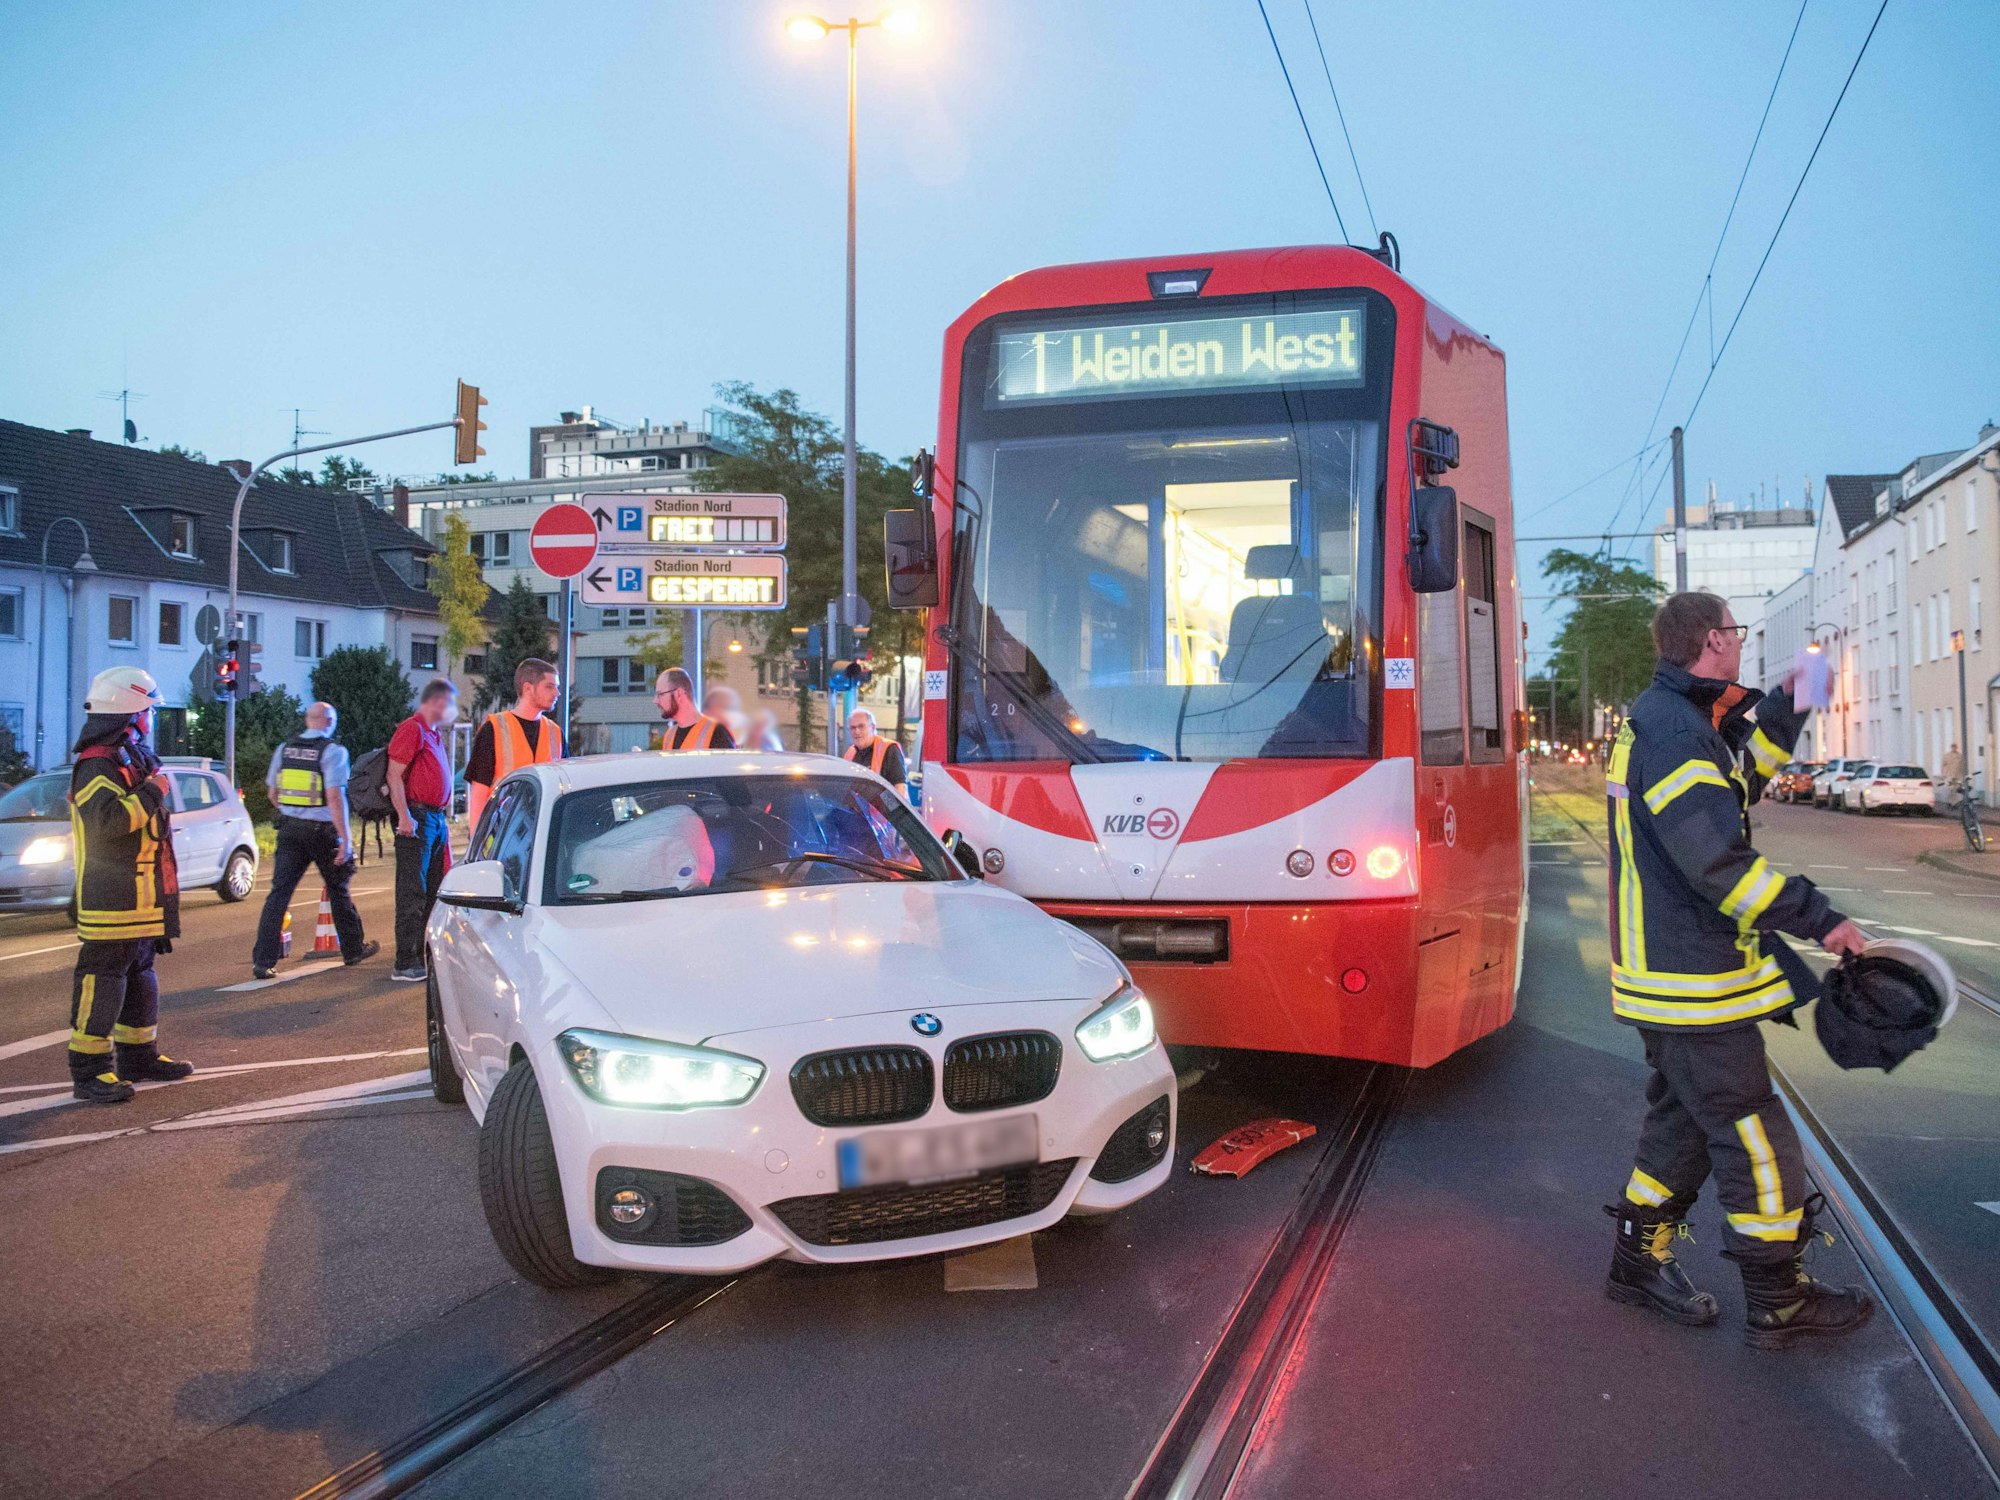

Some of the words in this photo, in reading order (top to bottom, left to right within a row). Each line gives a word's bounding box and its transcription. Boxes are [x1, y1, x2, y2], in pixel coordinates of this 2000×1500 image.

[1032, 332, 1045, 394] 1
[1072, 329, 1223, 383] Weiden
[1242, 317, 1356, 373] West
[654, 499, 699, 512] Stadion
[704, 499, 732, 513] Nord
[622, 509, 637, 529] P
[651, 517, 714, 542] FREI
[654, 560, 699, 572] Stadion
[704, 560, 732, 572] Nord
[651, 576, 774, 602] GESPERRT
[1103, 815, 1146, 833] KVB
